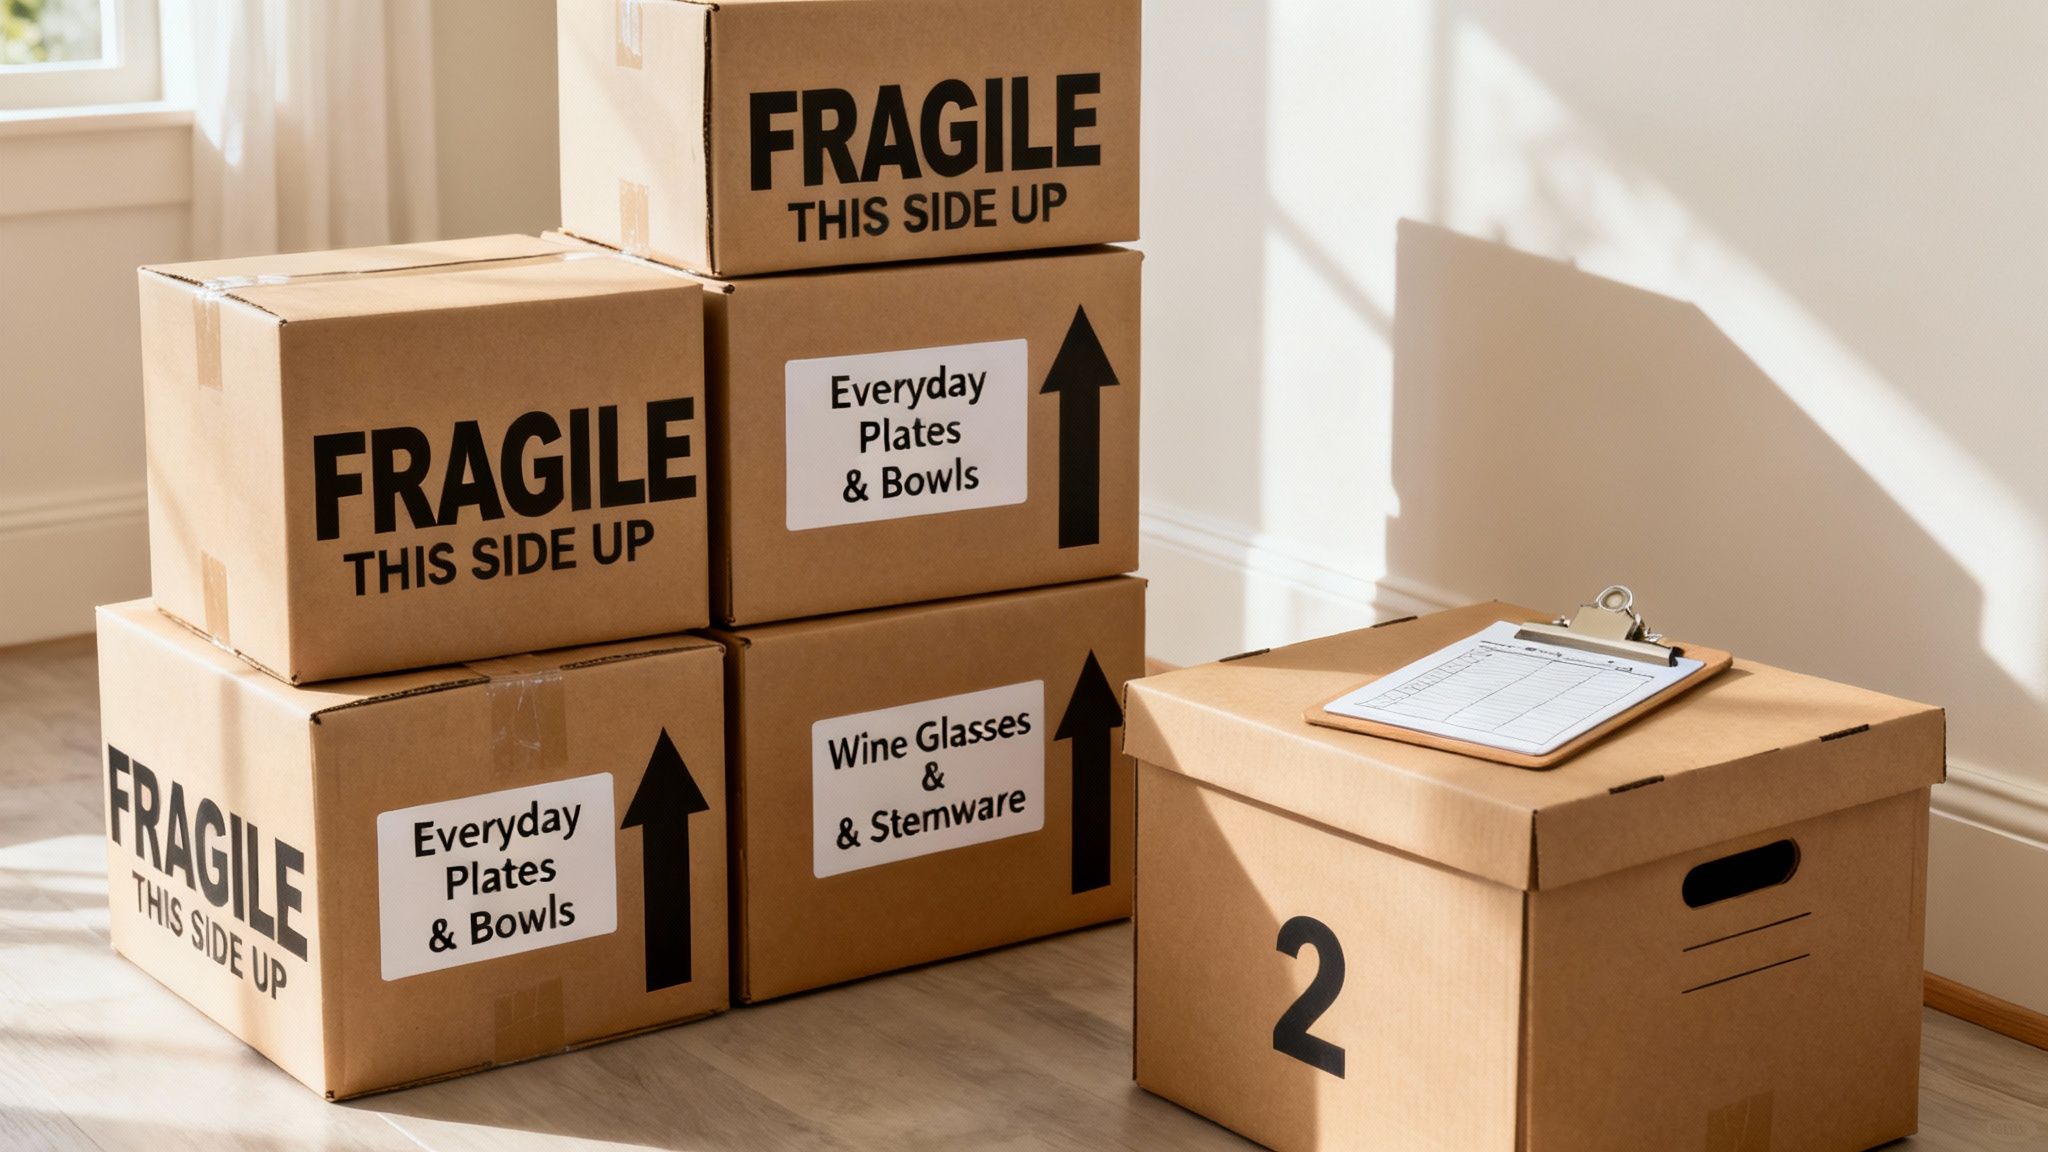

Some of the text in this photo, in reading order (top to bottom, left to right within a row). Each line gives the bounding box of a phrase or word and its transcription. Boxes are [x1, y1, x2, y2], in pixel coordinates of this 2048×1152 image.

[750, 73, 1101, 191] FRAGILE
[788, 183, 1067, 242] THIS SIDE UP
[832, 365, 986, 410] Everyday
[861, 418, 960, 453] Plates
[314, 397, 696, 541] FRAGILE
[843, 457, 979, 503] & Bowls
[343, 519, 654, 596] THIS SIDE UP
[829, 713, 1031, 770] Wine Glasses
[922, 761, 944, 791] &
[415, 801, 581, 857] Everyday
[837, 790, 1026, 850] & Stemware
[108, 744, 308, 963] FRAGILE
[447, 859, 556, 900] Plates
[133, 871, 286, 999] THIS SIDE UP
[429, 893, 575, 952] & Bowls
[1273, 916, 1345, 1078] 2
